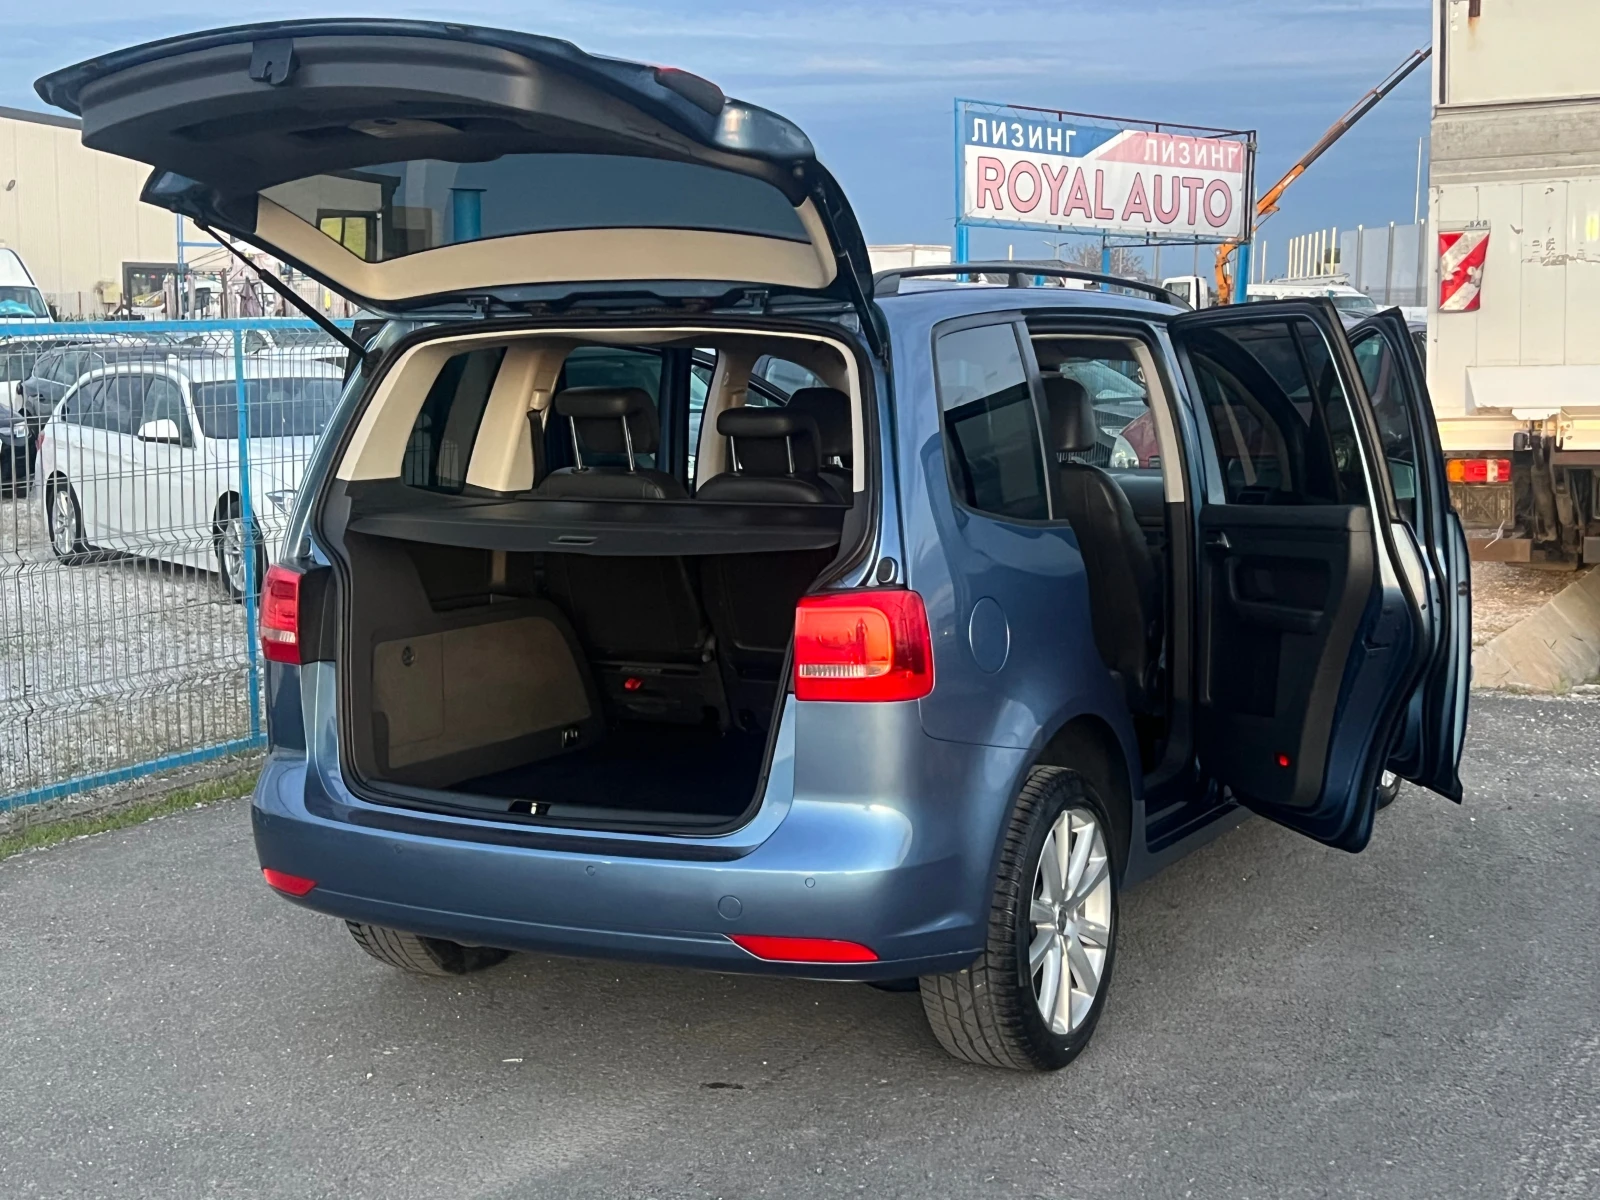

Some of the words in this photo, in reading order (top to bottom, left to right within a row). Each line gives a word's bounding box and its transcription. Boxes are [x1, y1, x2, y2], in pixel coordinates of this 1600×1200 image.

[971, 118, 1076, 153] ЛИЗИНГ
[1143, 139, 1239, 169] ЛИЗИНГ
[977, 156, 1115, 220] ROYAL
[1121, 172, 1233, 228] AUTO
